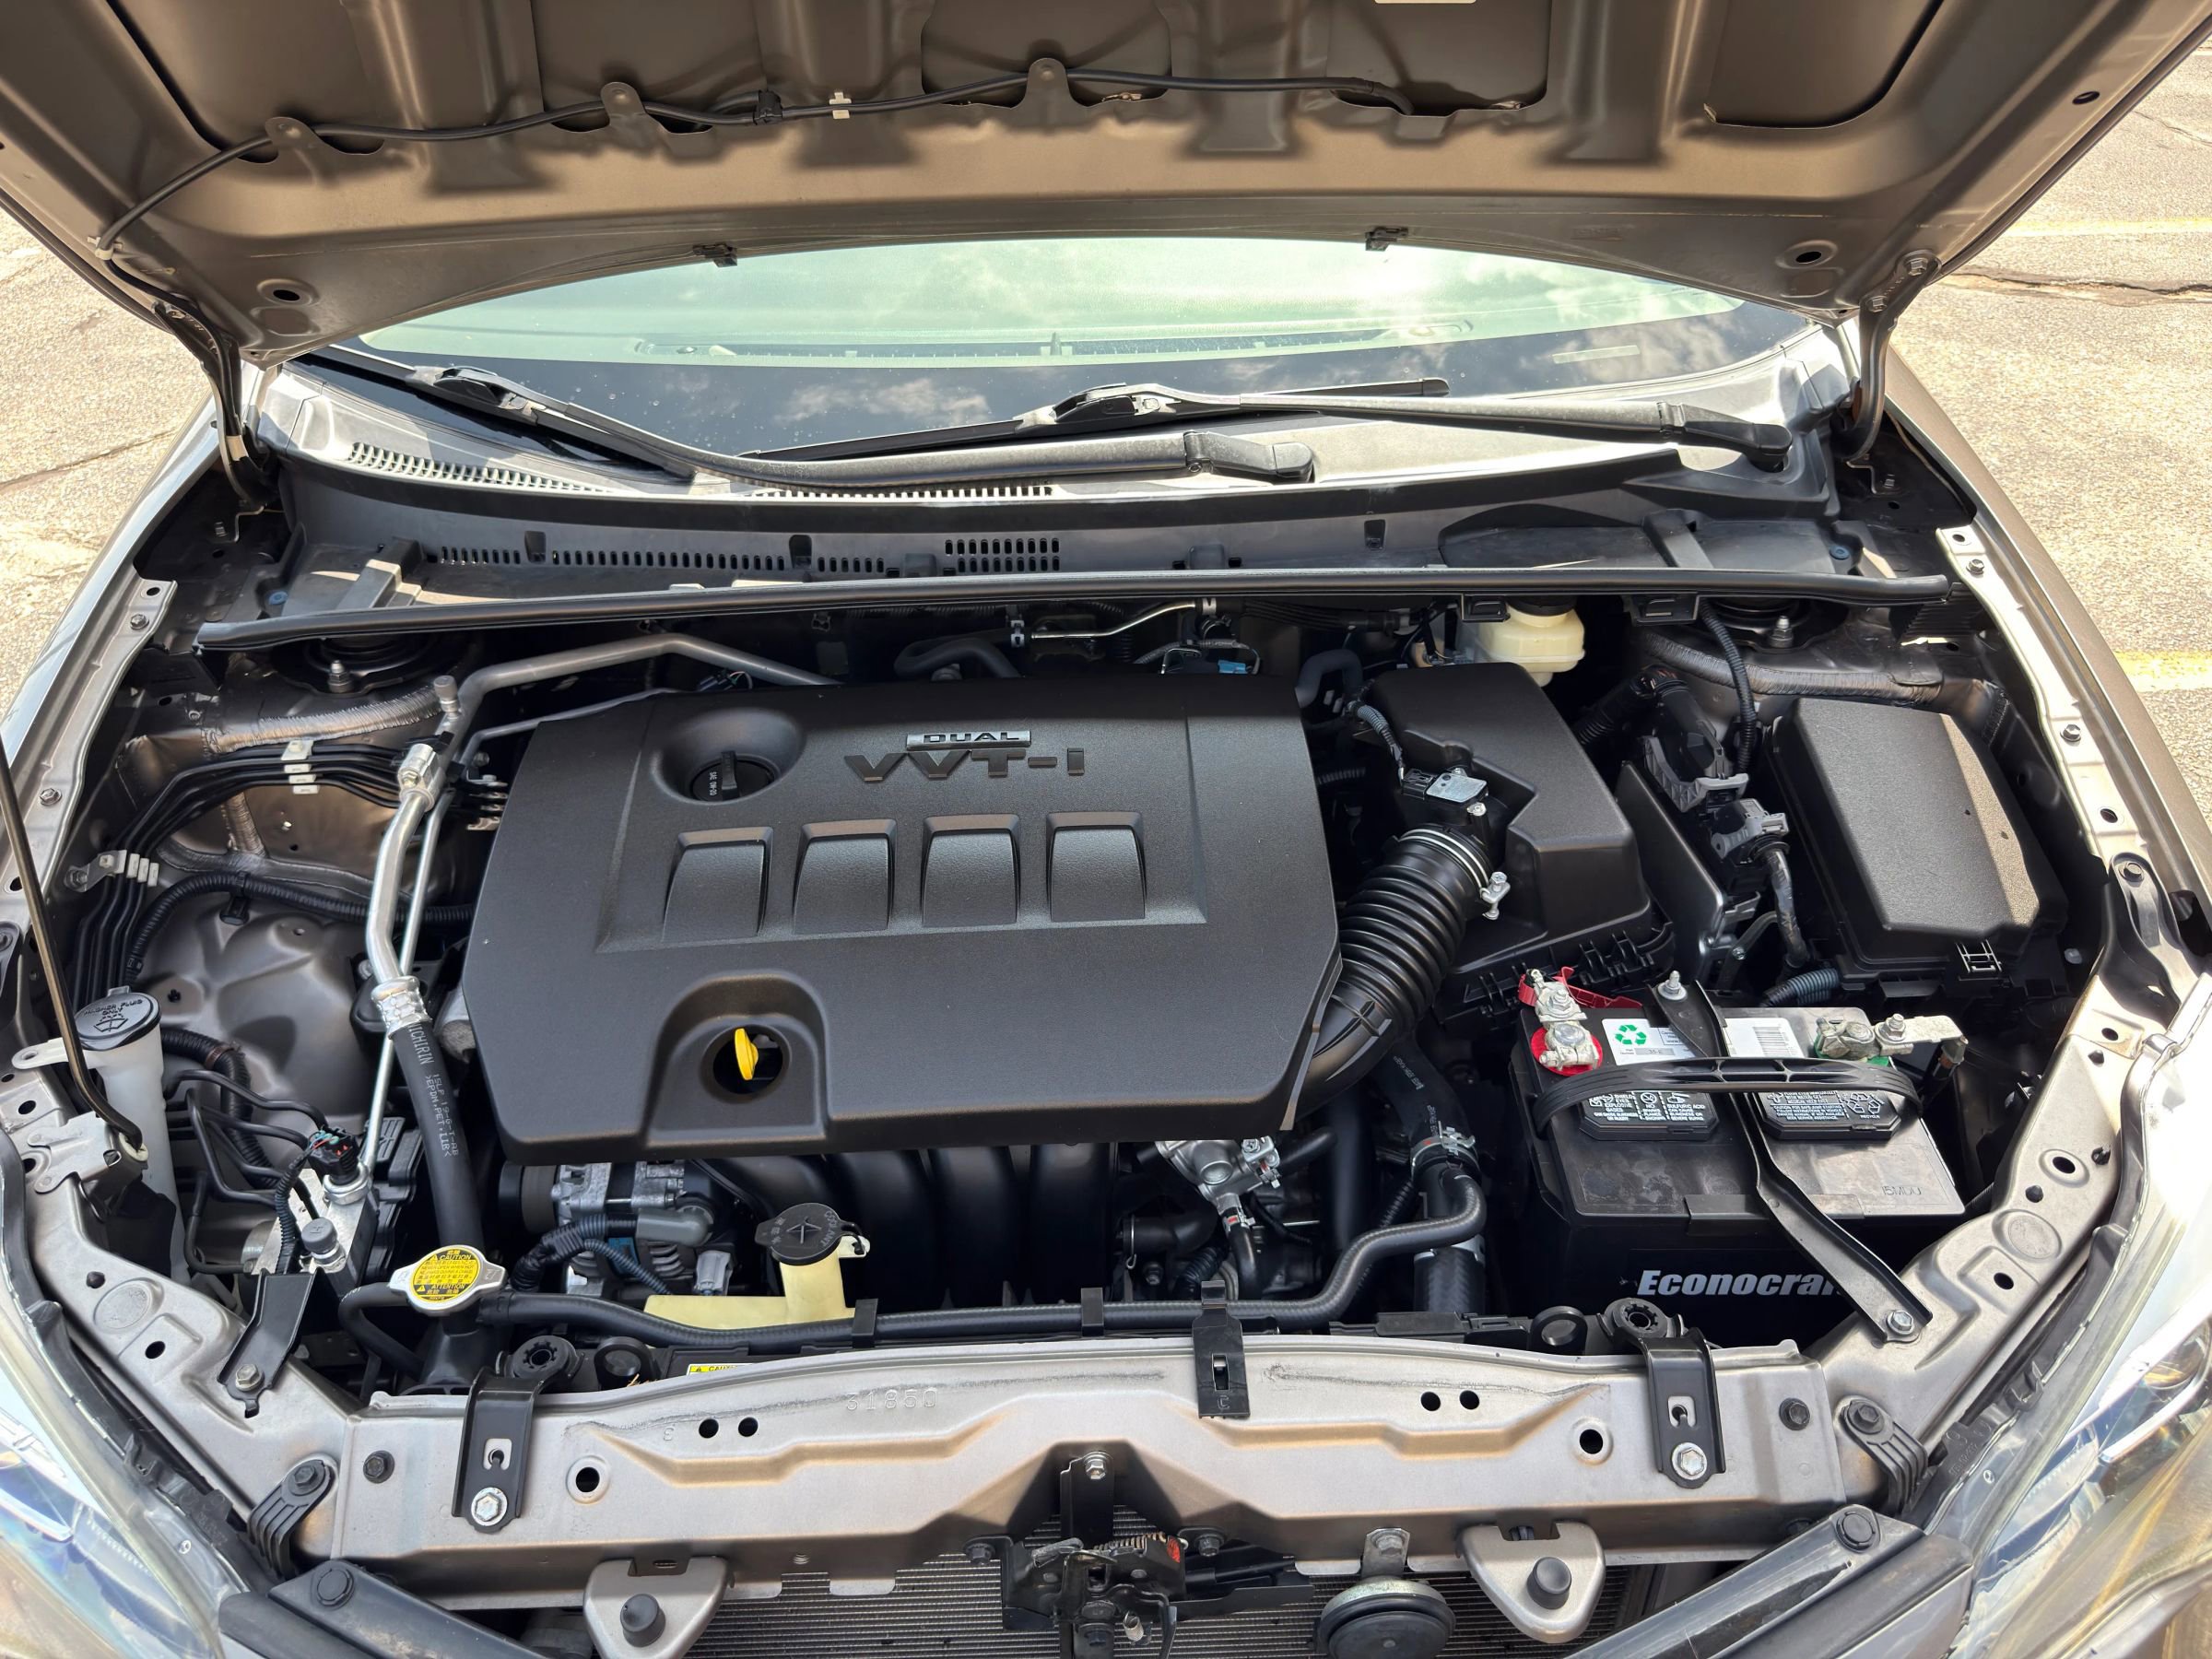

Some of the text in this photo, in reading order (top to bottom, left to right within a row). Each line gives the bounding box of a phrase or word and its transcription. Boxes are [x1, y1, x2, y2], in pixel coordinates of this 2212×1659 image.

[923, 731, 1020, 742] DUAL
[708, 771, 718, 781] SAE
[84, 999, 143, 1016] WASHER FLUID
[101, 1006, 124, 1016] ONLY
[1637, 1269, 1841, 1296] Econocra
[846, 1387, 938, 1411] 31850
